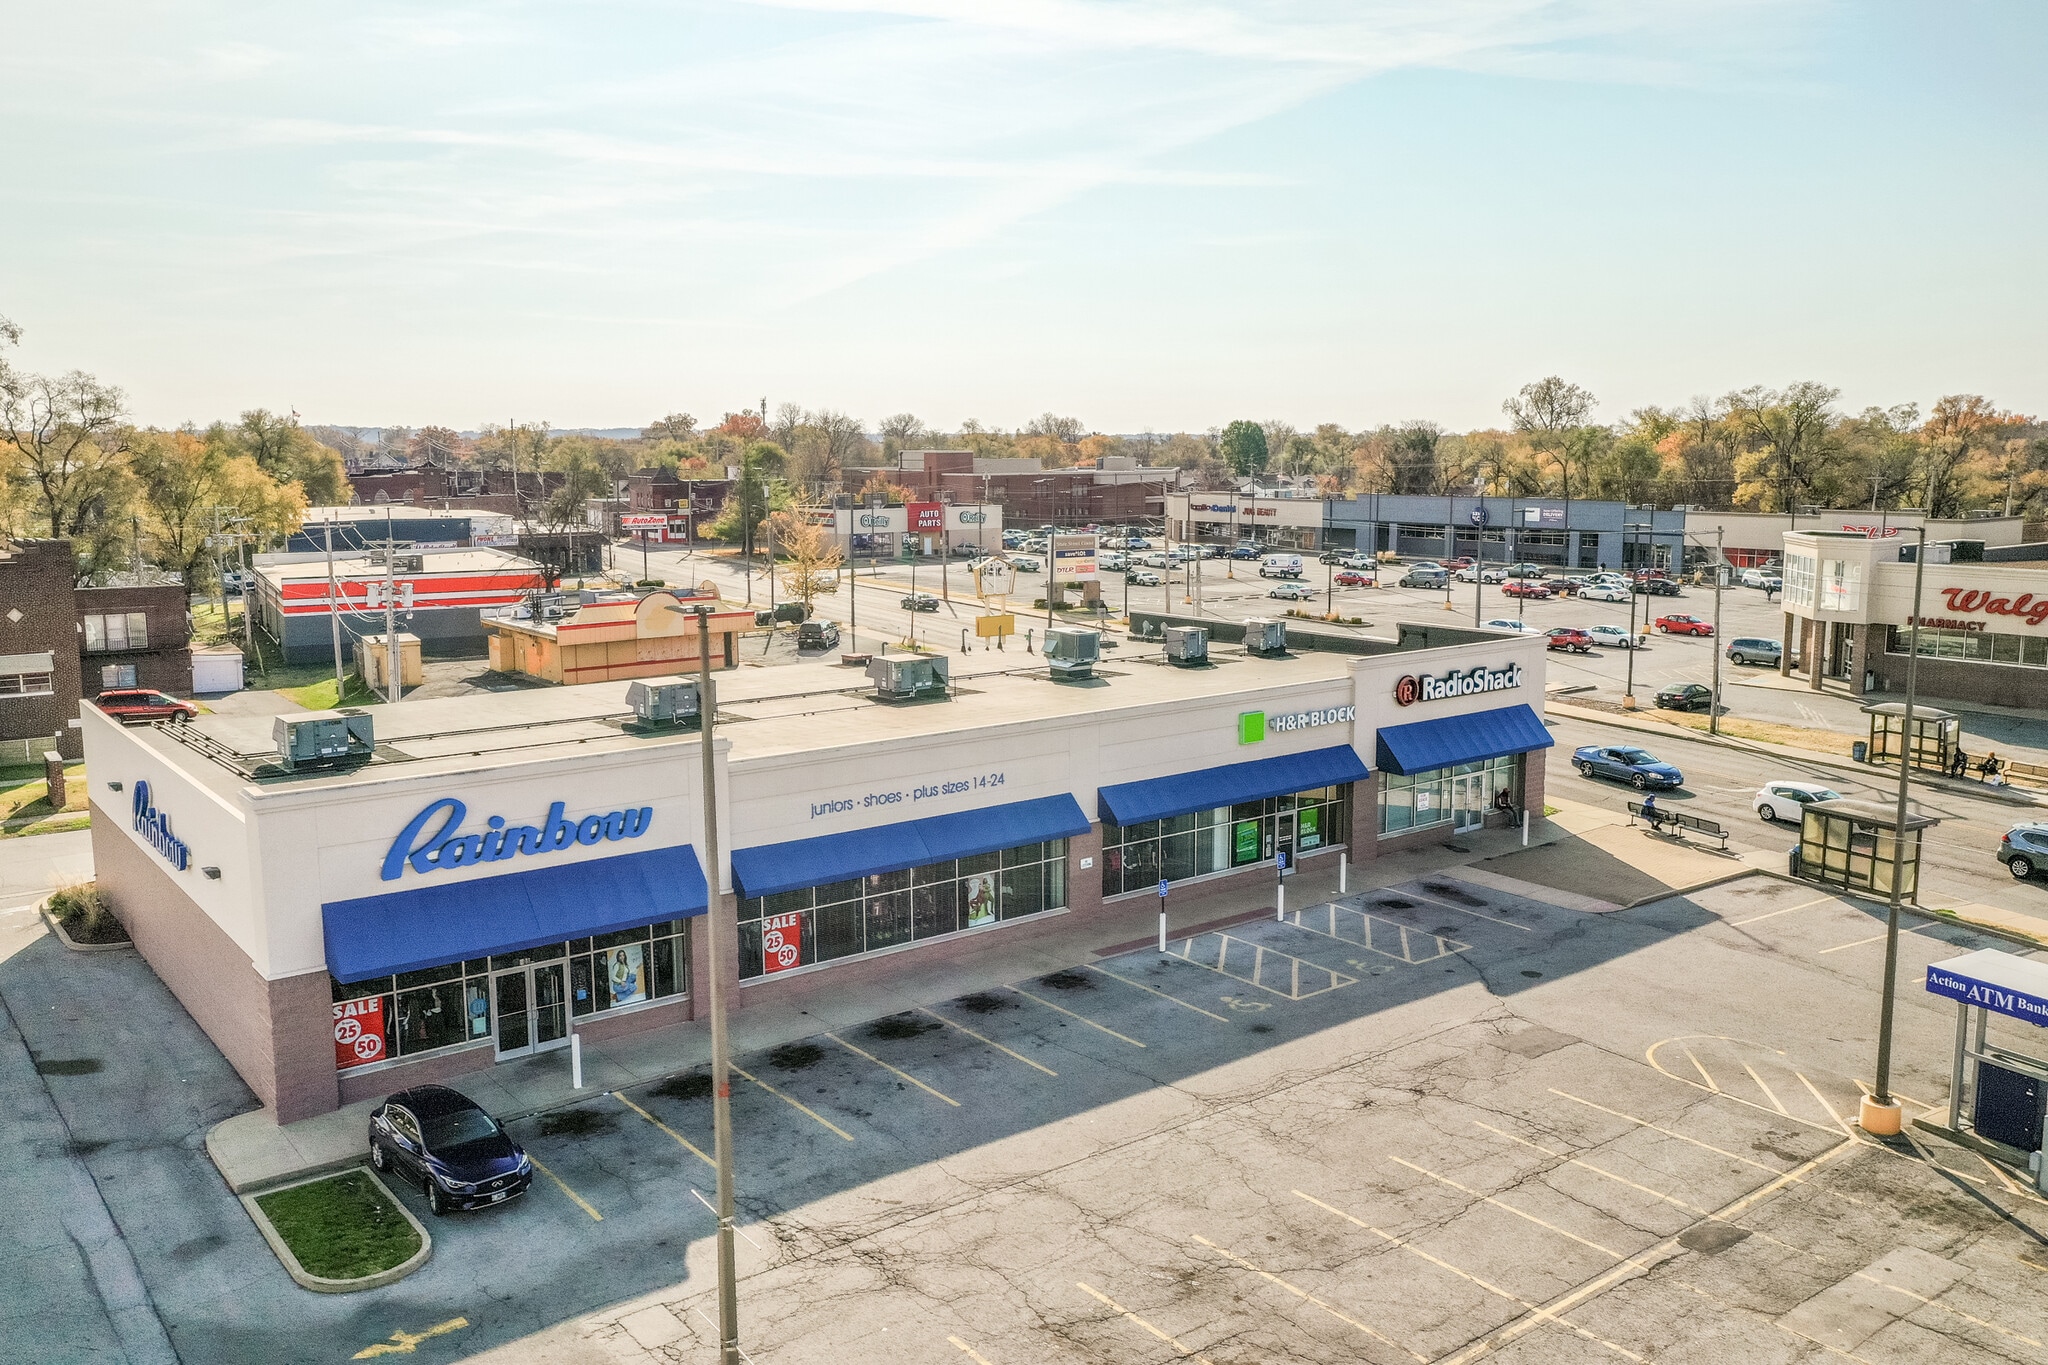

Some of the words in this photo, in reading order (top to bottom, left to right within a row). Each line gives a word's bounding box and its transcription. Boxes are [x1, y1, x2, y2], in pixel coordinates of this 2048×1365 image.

[631, 516, 665, 524] AutoZone
[918, 519, 941, 527] PARTS
[920, 510, 939, 518] AUTO
[1907, 616, 1987, 631] PHARMACY
[1422, 663, 1522, 701] RadioShack
[1276, 713, 1306, 732] H&R
[1311, 706, 1356, 727] BLOCK
[810, 799, 853, 819] juniors
[863, 791, 902, 808] shoes
[913, 785, 939, 802] plus
[941, 779, 970, 794] sizes
[972, 773, 1005, 789] 14-24
[132, 780, 187, 871] Rainbow
[381, 797, 653, 881] Rainbow
[763, 914, 796, 930] SALE
[1929, 972, 1966, 992] Action
[1967, 984, 2016, 1012] ATM
[2017, 997, 2048, 1017] Bank
[333, 999, 378, 1019] SALE
